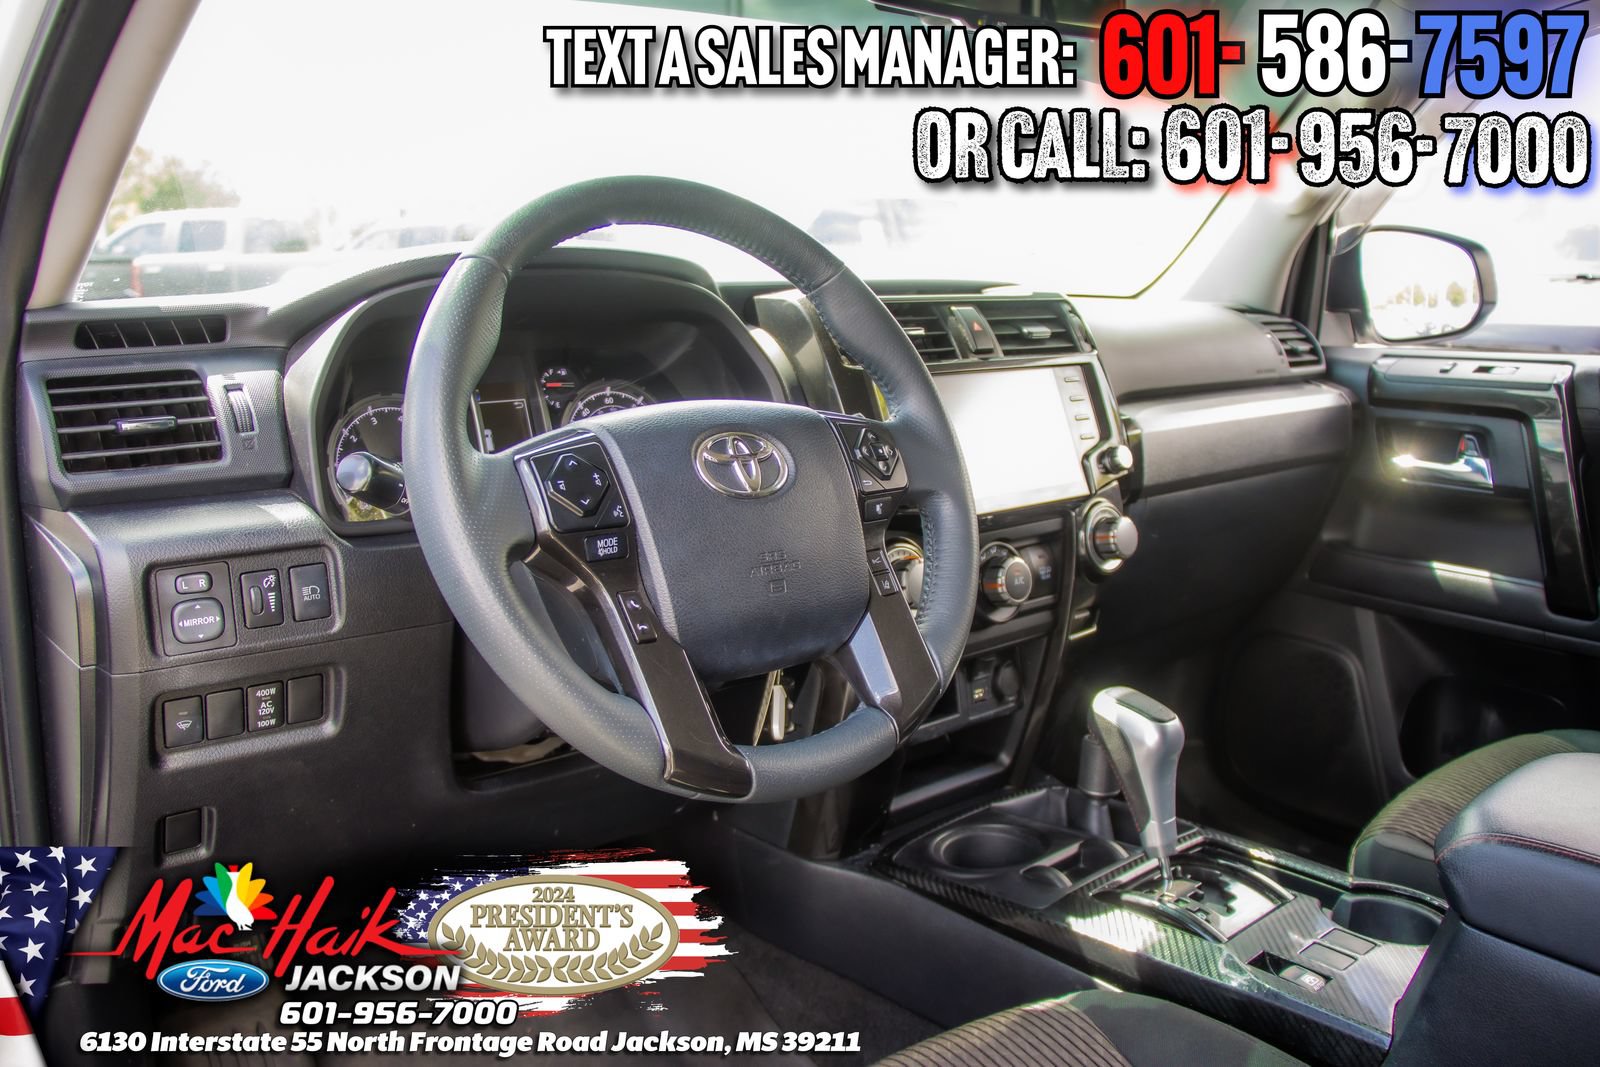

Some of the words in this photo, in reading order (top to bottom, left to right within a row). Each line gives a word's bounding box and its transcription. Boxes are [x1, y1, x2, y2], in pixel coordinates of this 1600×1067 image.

[581, 408, 591, 417] 40
[370, 417, 378, 426] 3
[350, 435, 358, 443] 2
[597, 537, 618, 548] MODE
[182, 581, 189, 589] L
[199, 579, 206, 587] R
[183, 616, 215, 627] MIRROR
[256, 688, 276, 697] 400W
[260, 701, 273, 709] AC
[258, 707, 275, 716] 120V
[257, 719, 276, 728] 100W
